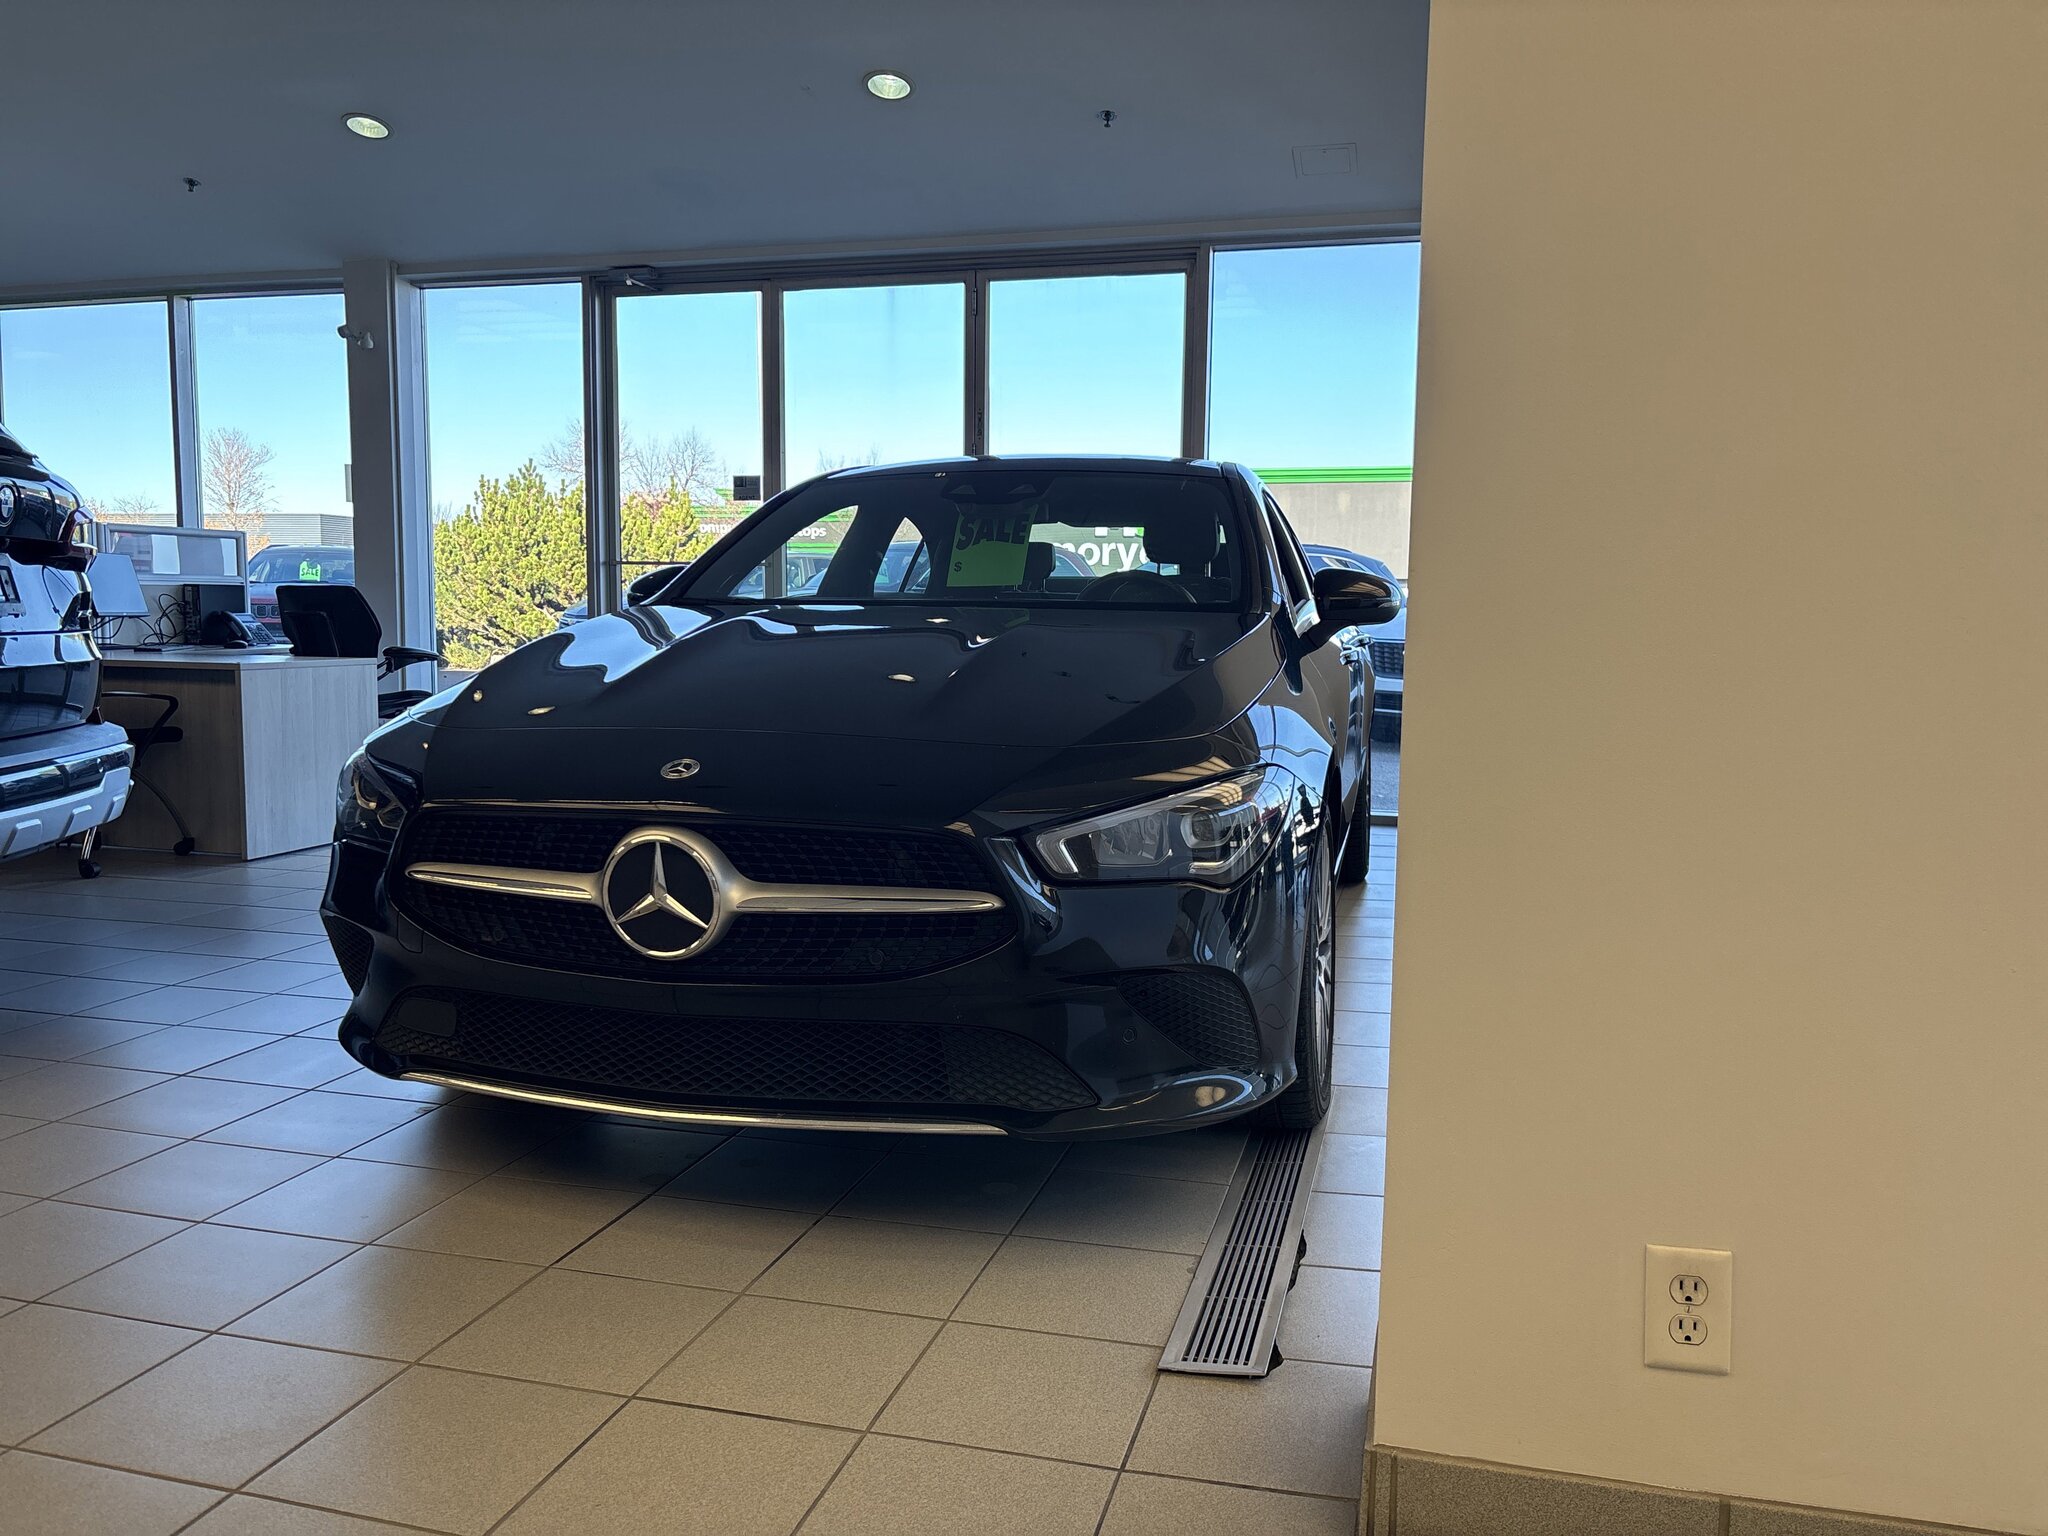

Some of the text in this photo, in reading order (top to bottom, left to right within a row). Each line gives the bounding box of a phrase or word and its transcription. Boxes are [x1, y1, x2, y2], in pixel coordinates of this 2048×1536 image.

[955, 512, 1031, 550] SALE
[301, 567, 319, 577] SALE
[953, 561, 962, 572] $
